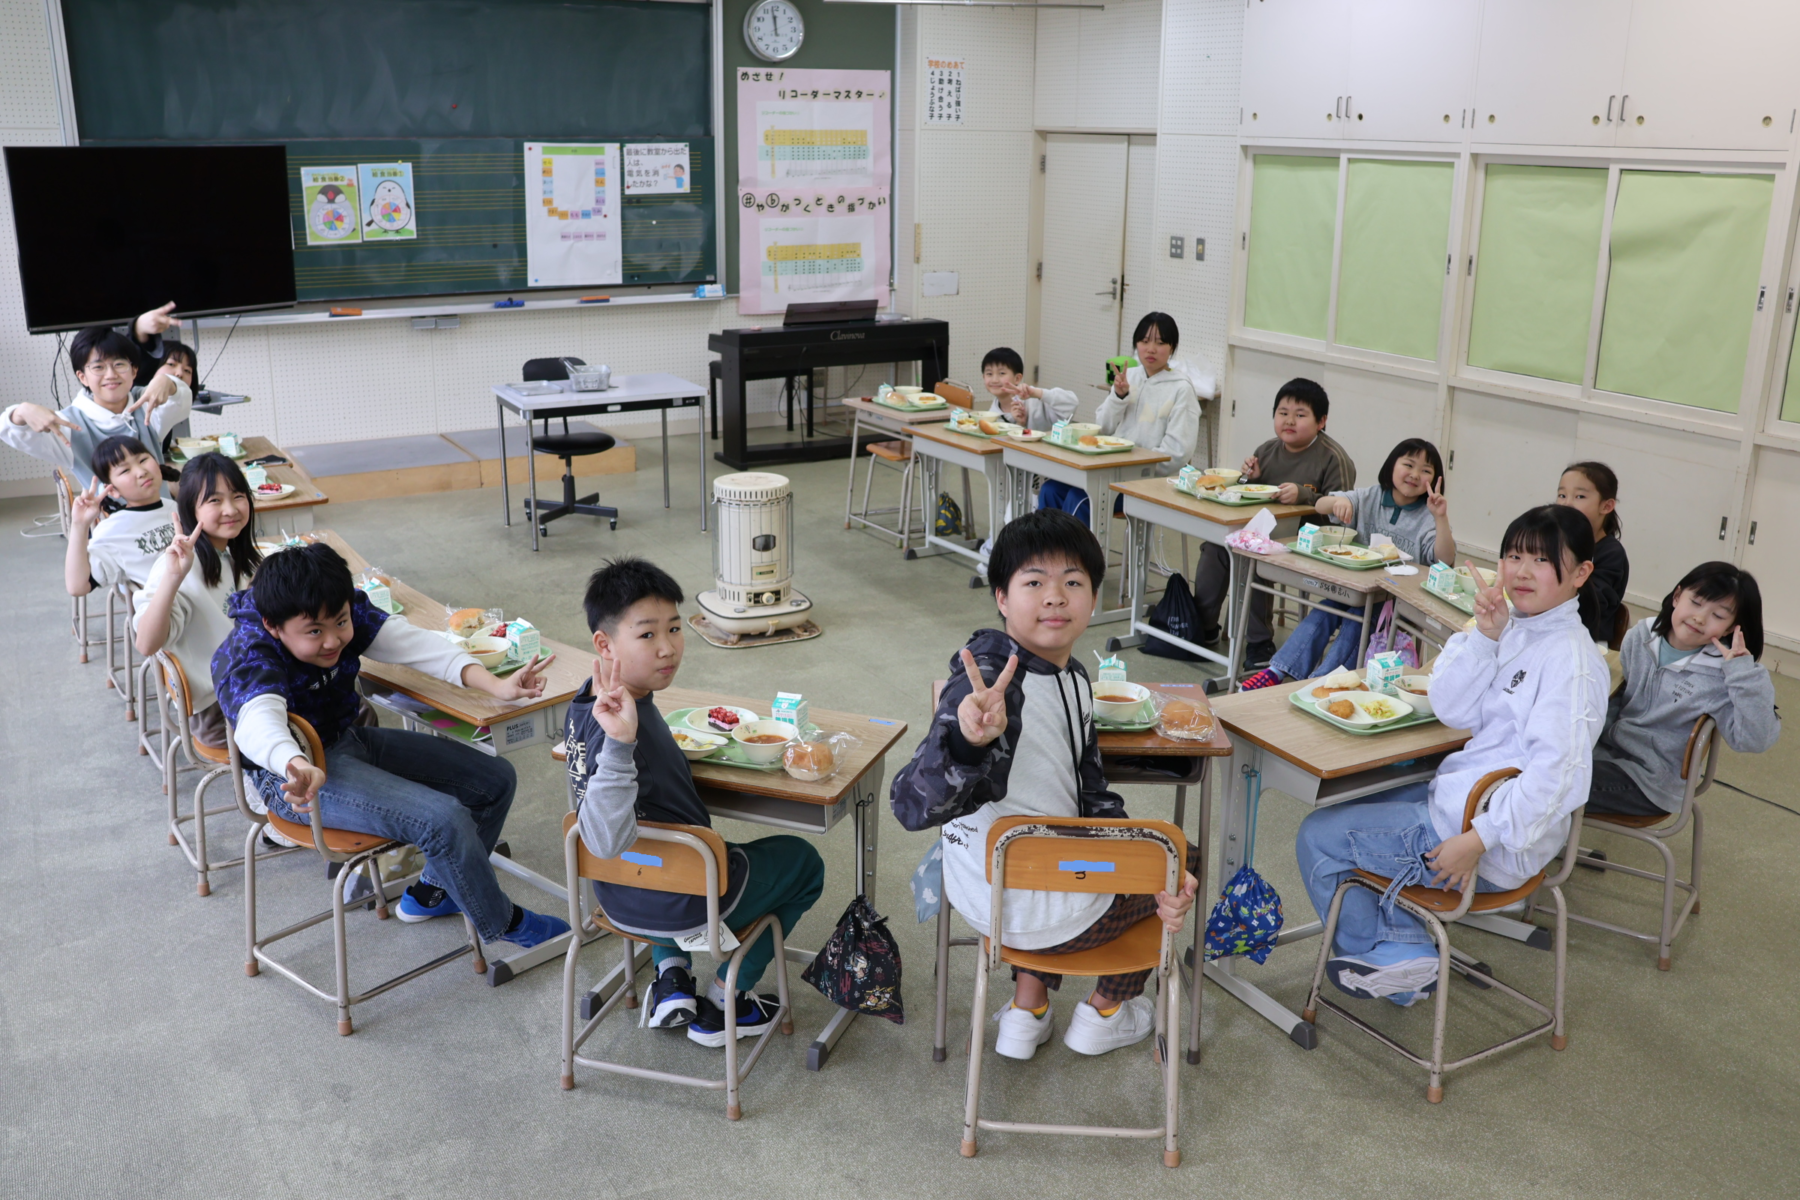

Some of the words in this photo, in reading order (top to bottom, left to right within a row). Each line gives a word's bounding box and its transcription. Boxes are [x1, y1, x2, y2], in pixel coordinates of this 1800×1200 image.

[928, 59, 965, 69] 学校のめあて
[626, 147, 687, 156] 最後に教室から出た
[627, 159, 644, 167] 人は、
[626, 169, 660, 178] 電気を消
[830, 325, 866, 341] Clavinova
[507, 723, 519, 731] PLUS
